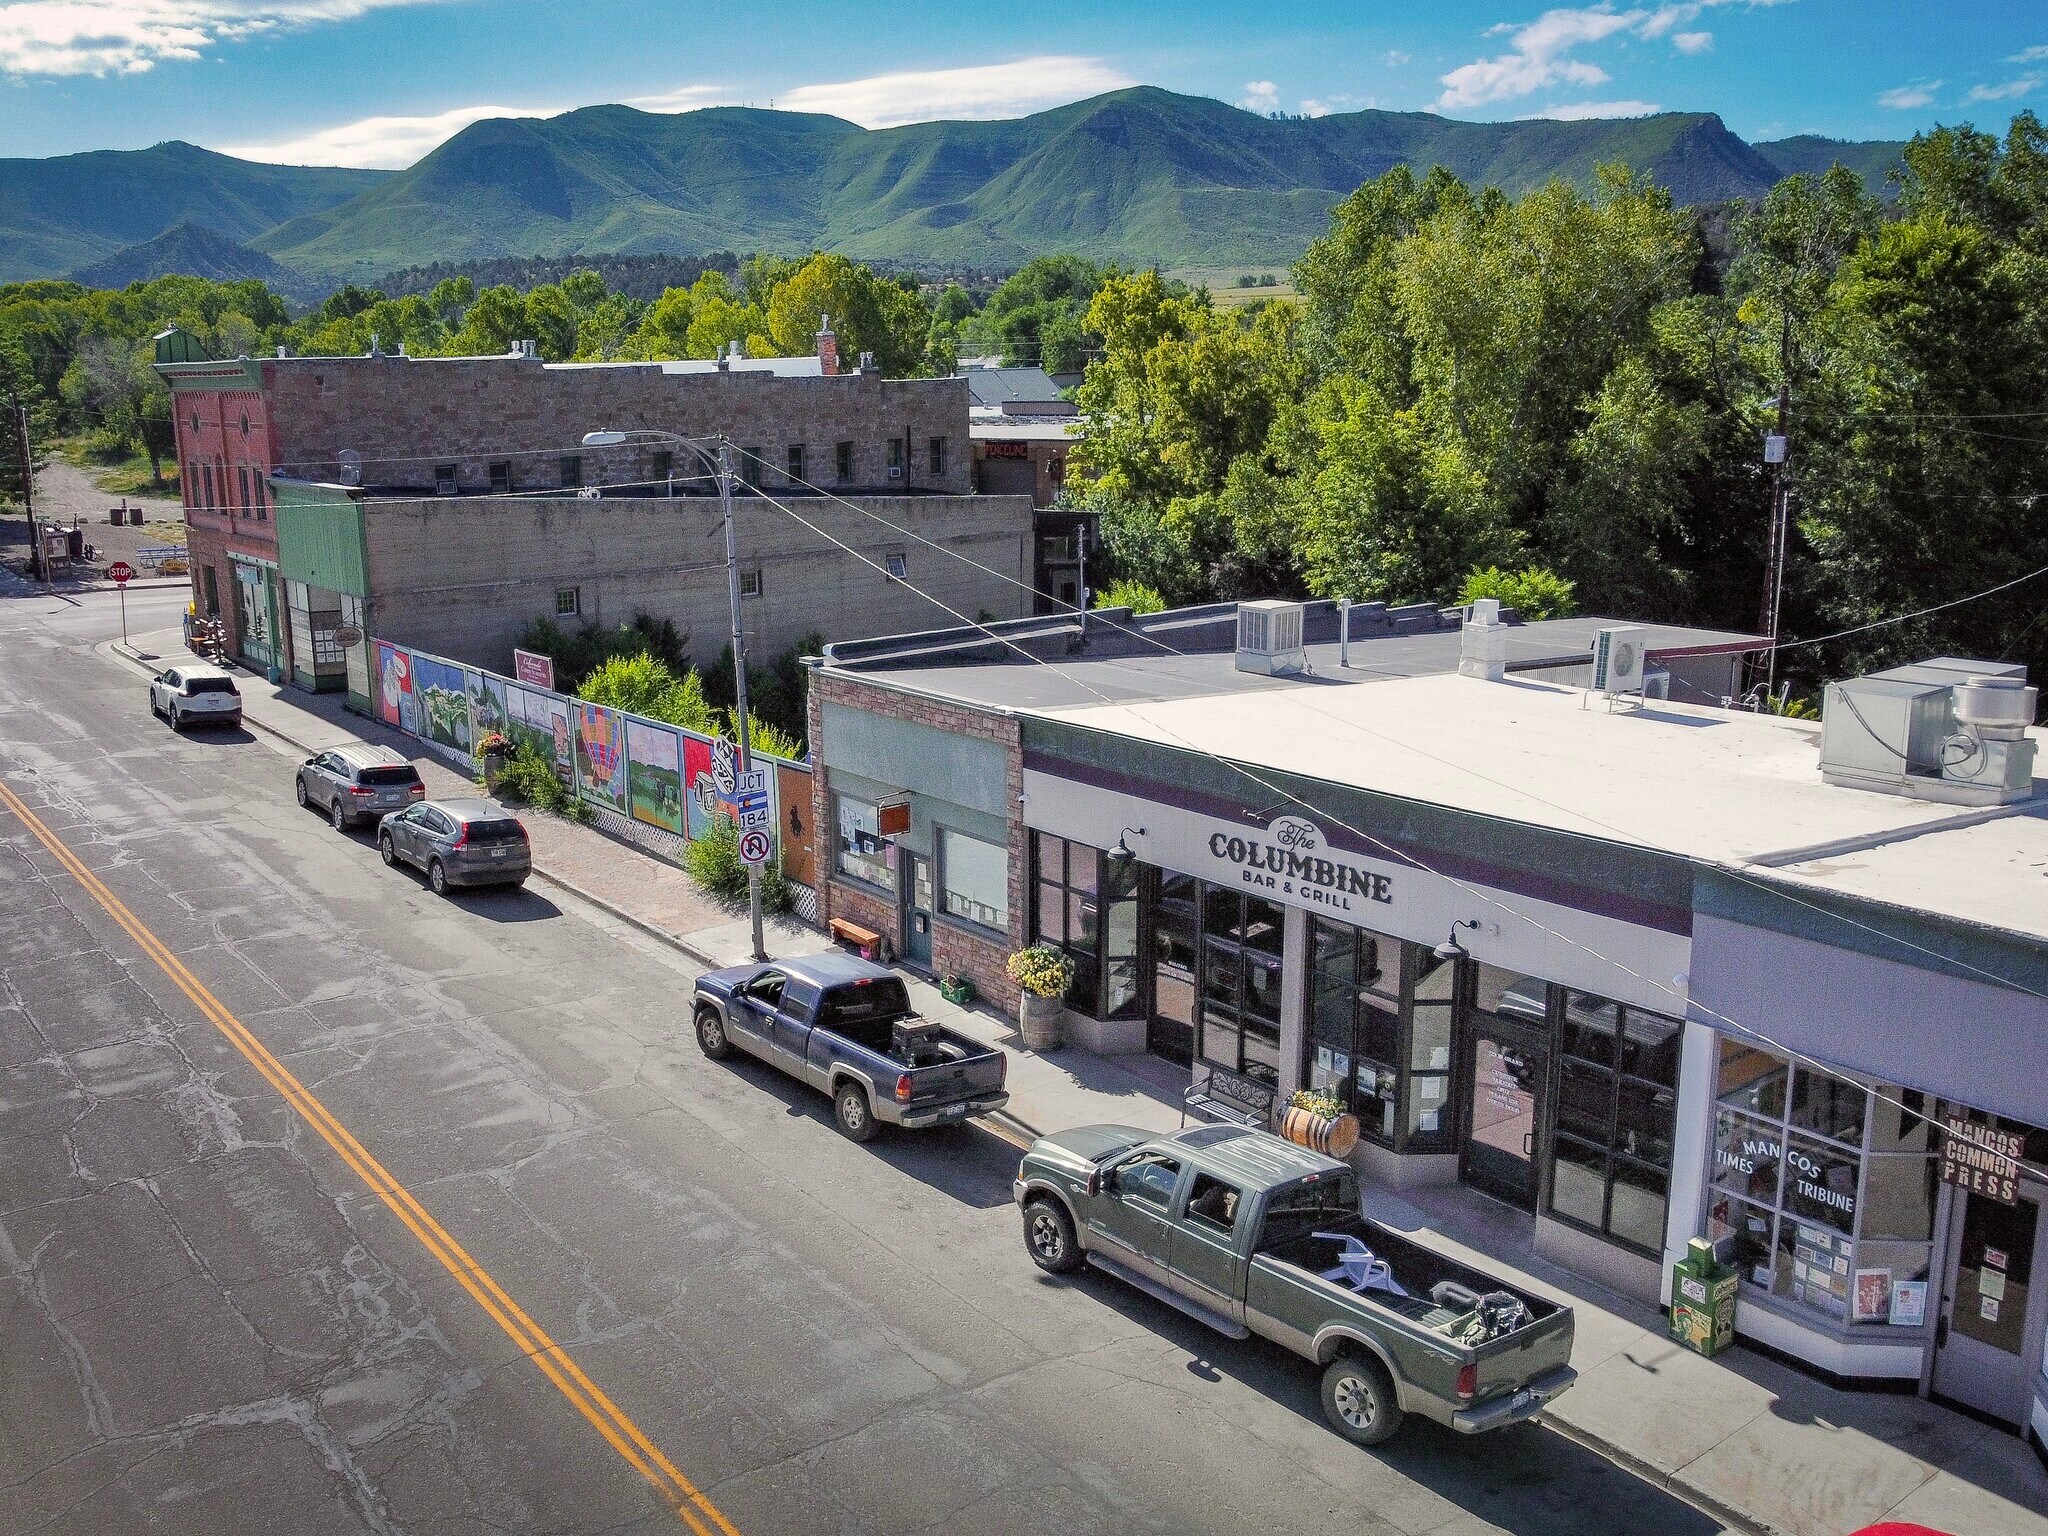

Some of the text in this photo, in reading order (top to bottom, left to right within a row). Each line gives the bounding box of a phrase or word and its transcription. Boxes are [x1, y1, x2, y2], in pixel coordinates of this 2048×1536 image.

[110, 568, 131, 576] STOP
[740, 774, 763, 790] JCT
[741, 810, 767, 827] 184
[1277, 820, 1315, 851] The
[1208, 832, 1392, 904] COLUMBINE
[1242, 870, 1352, 911] BAR & GRILL
[1949, 1119, 2020, 1158] MANCOS
[1743, 1141, 1822, 1179] MANCOS
[1946, 1140, 2017, 1179] COMMON
[1716, 1149, 1854, 1213] TIMES TRIBUNE
[1944, 1161, 2014, 1200] PRESS
